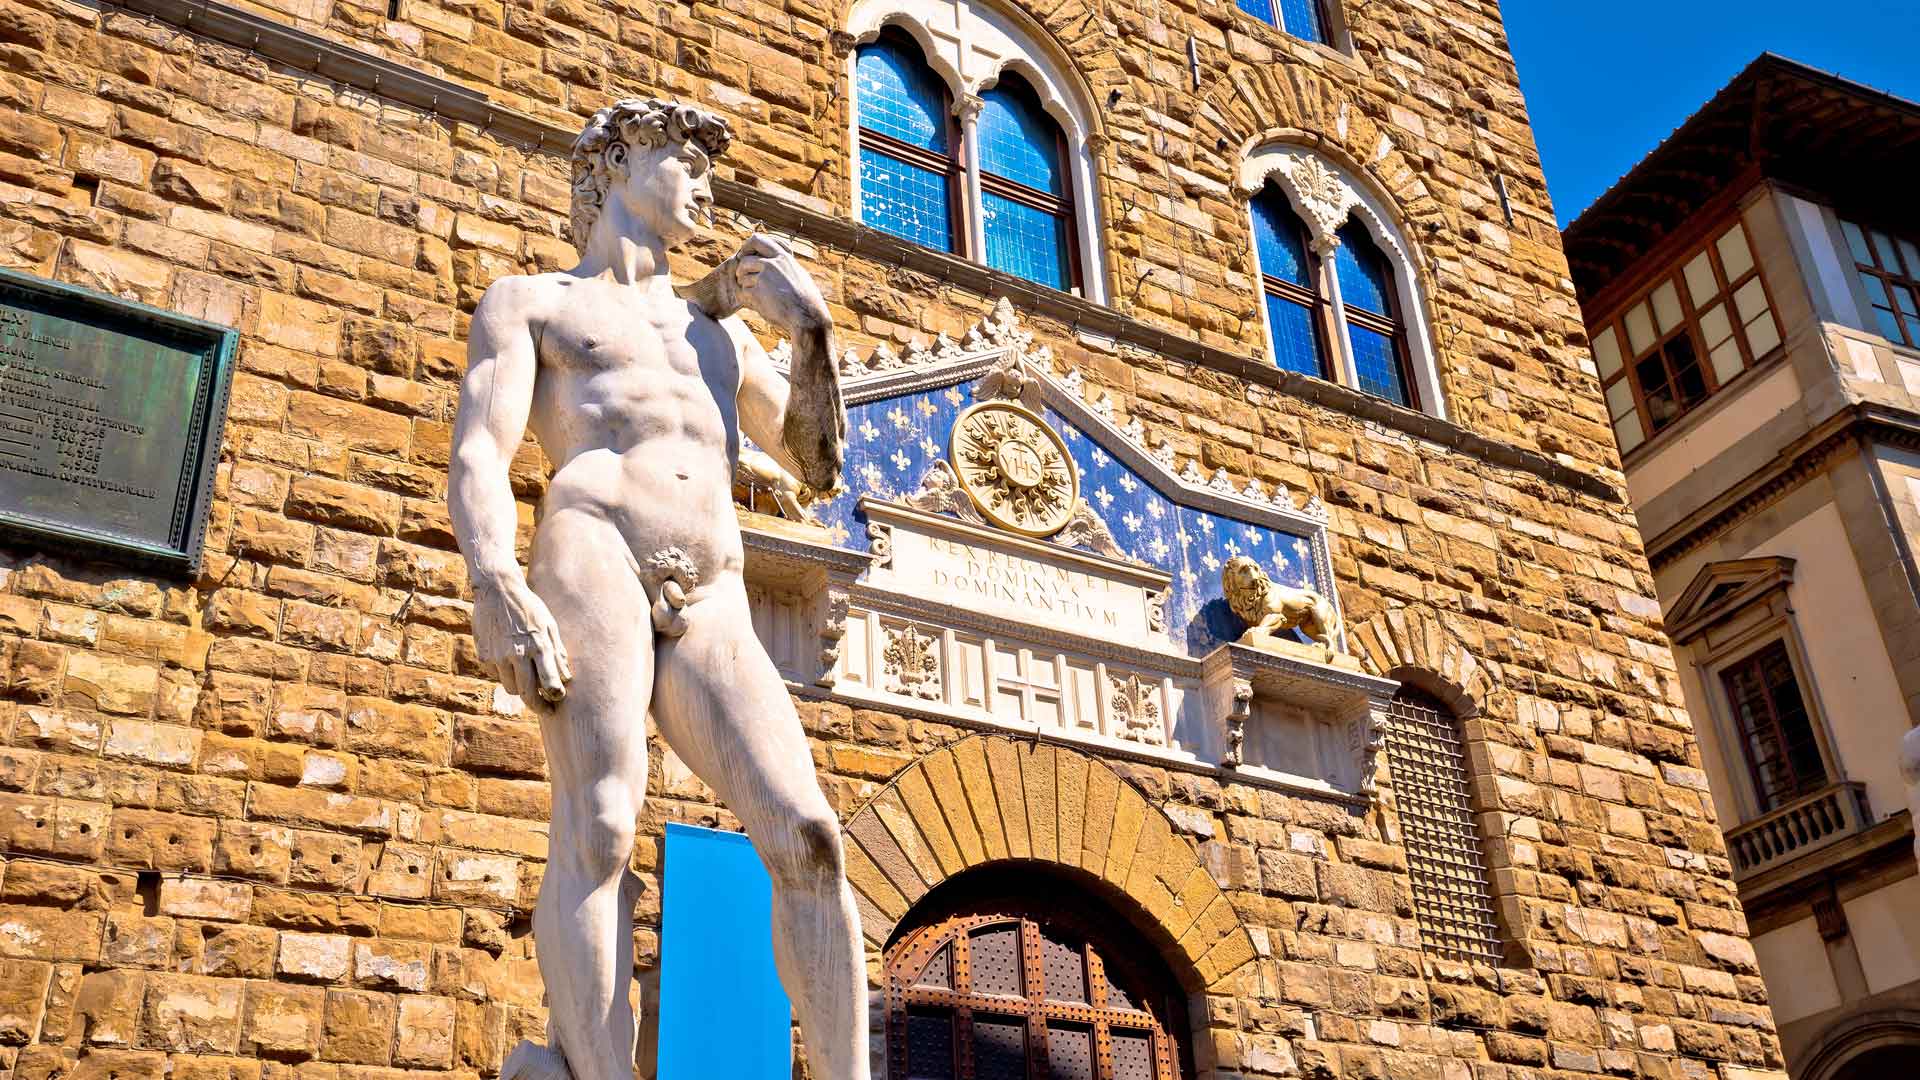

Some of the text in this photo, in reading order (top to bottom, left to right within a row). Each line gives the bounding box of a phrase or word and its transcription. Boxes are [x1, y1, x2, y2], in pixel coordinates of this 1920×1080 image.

[929, 536, 976, 560] REX
[988, 550, 1071, 583] REGVM
[967, 560, 1079, 598] DOMINVS
[933, 569, 1119, 627] DOMINANTIVM
